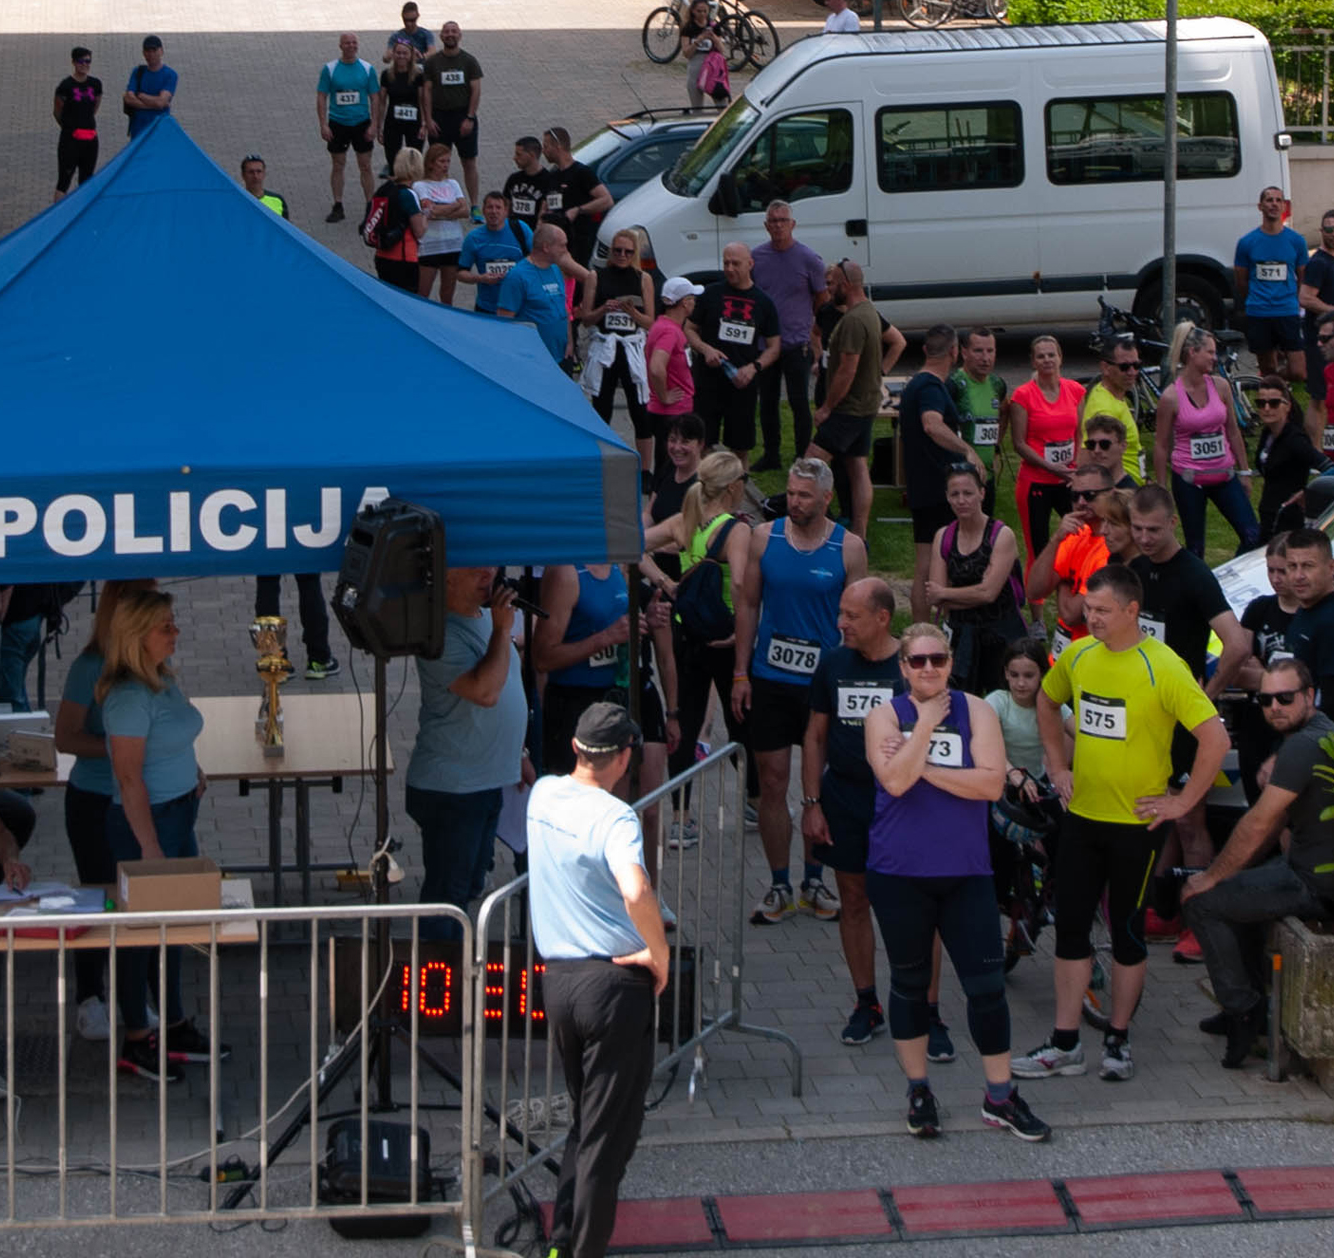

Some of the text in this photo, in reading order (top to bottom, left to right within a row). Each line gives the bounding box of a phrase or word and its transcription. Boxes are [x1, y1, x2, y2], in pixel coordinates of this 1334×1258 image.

[725, 326, 748, 340] 591
[1193, 440, 1224, 456] 3051
[771, 644, 816, 669] 3078
[846, 694, 882, 711] 576
[1084, 709, 1116, 729] 575
[929, 740, 951, 758] 73
